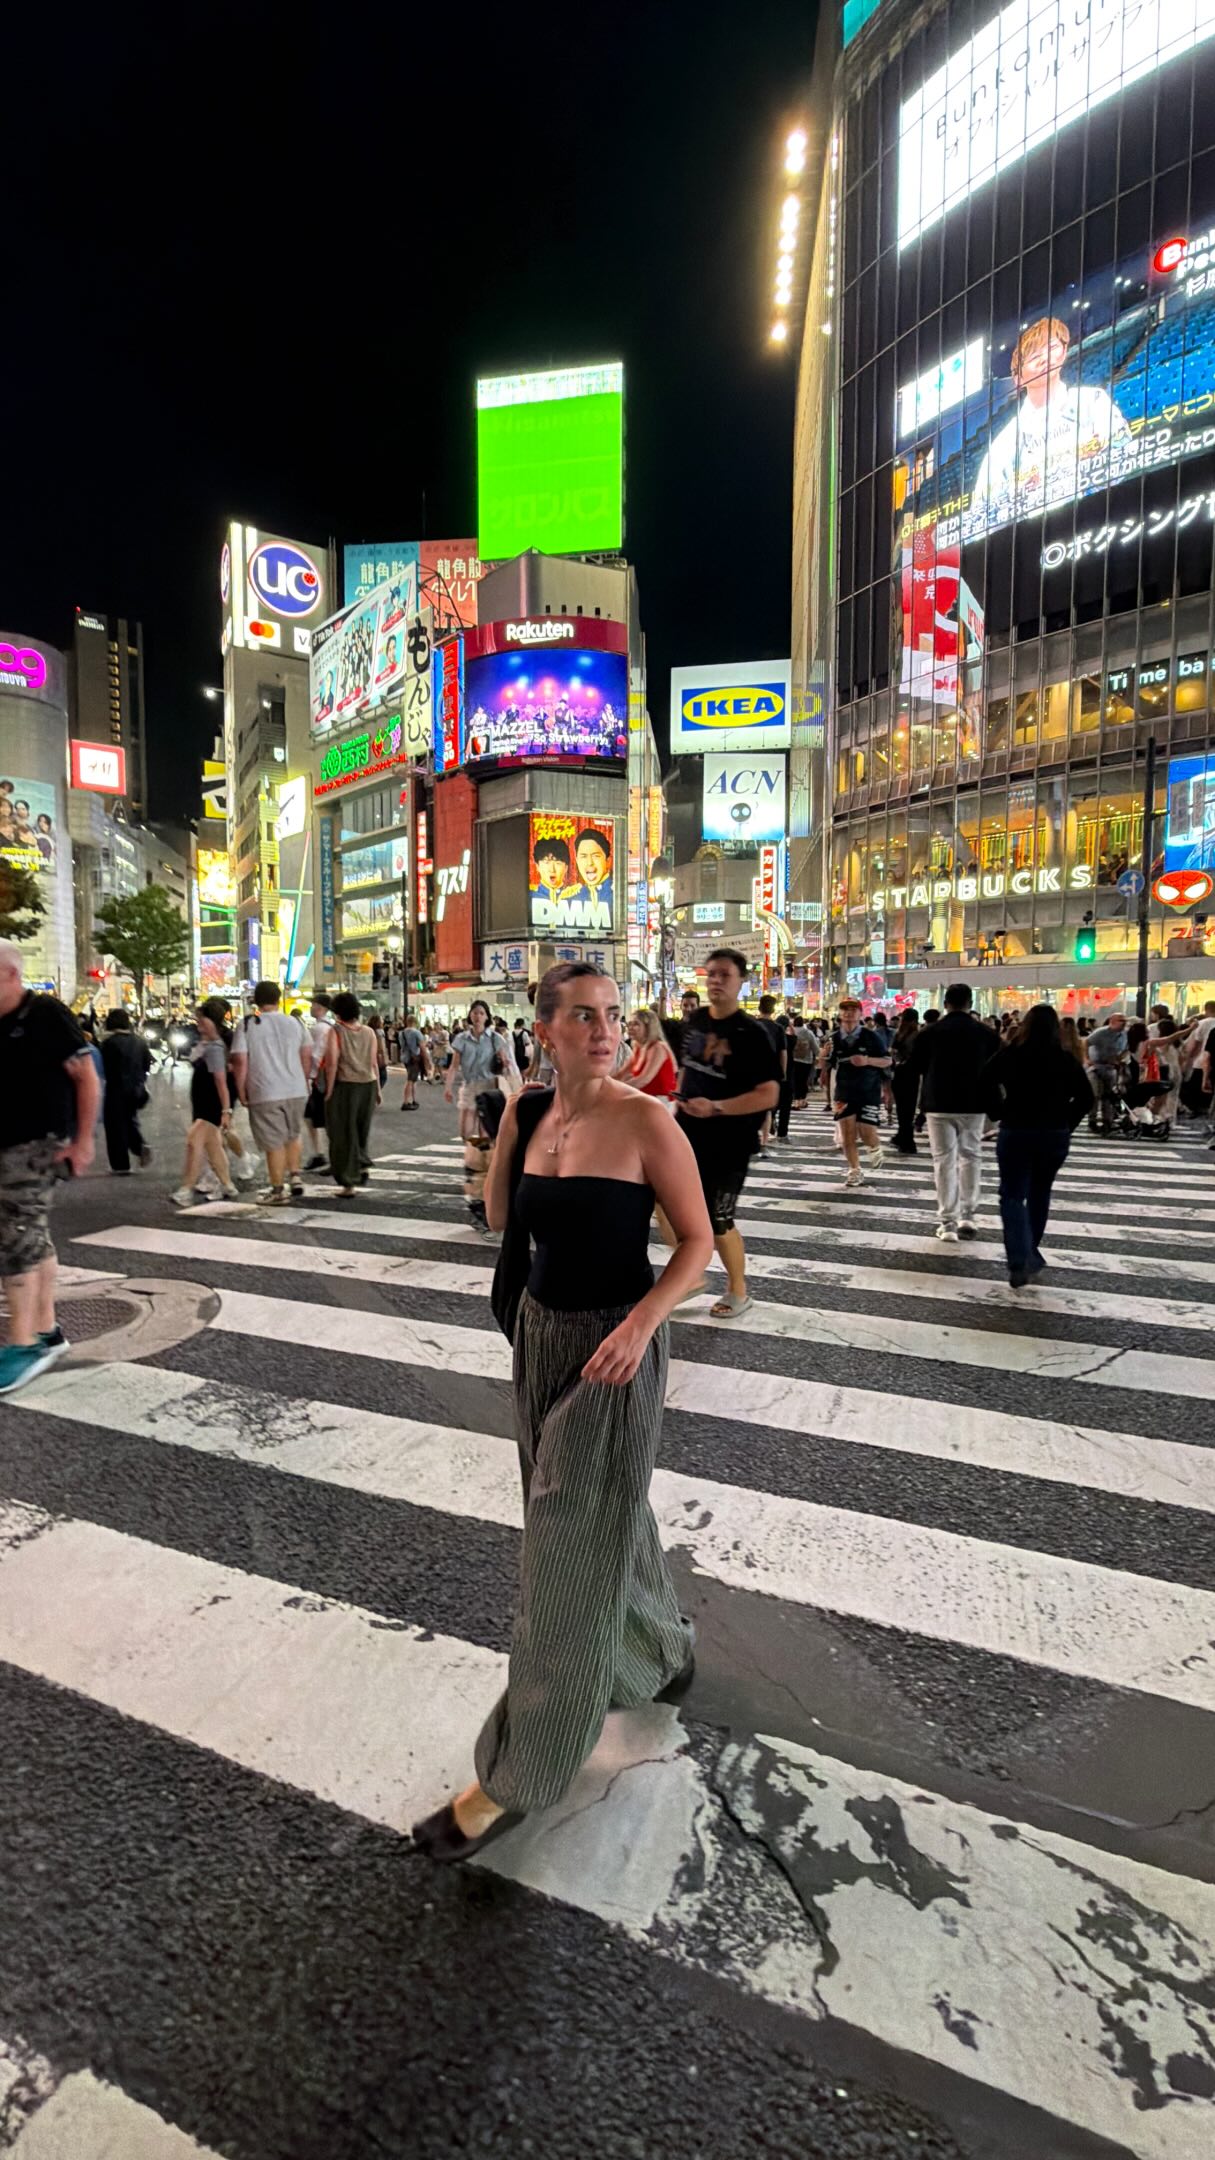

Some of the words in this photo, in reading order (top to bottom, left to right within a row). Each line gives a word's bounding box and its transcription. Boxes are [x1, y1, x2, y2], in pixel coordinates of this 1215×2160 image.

[937, 0, 1104, 139] Bunkamu
[506, 621, 574, 641] Rakuten
[693, 697, 776, 717] IKEA
[491, 722, 543, 737] MAZZEL
[706, 769, 783, 794] ACN
[872, 865, 1091, 911] STARBUCKS
[532, 898, 612, 928] DMM
[490, 949, 605, 971] 大盛書店
